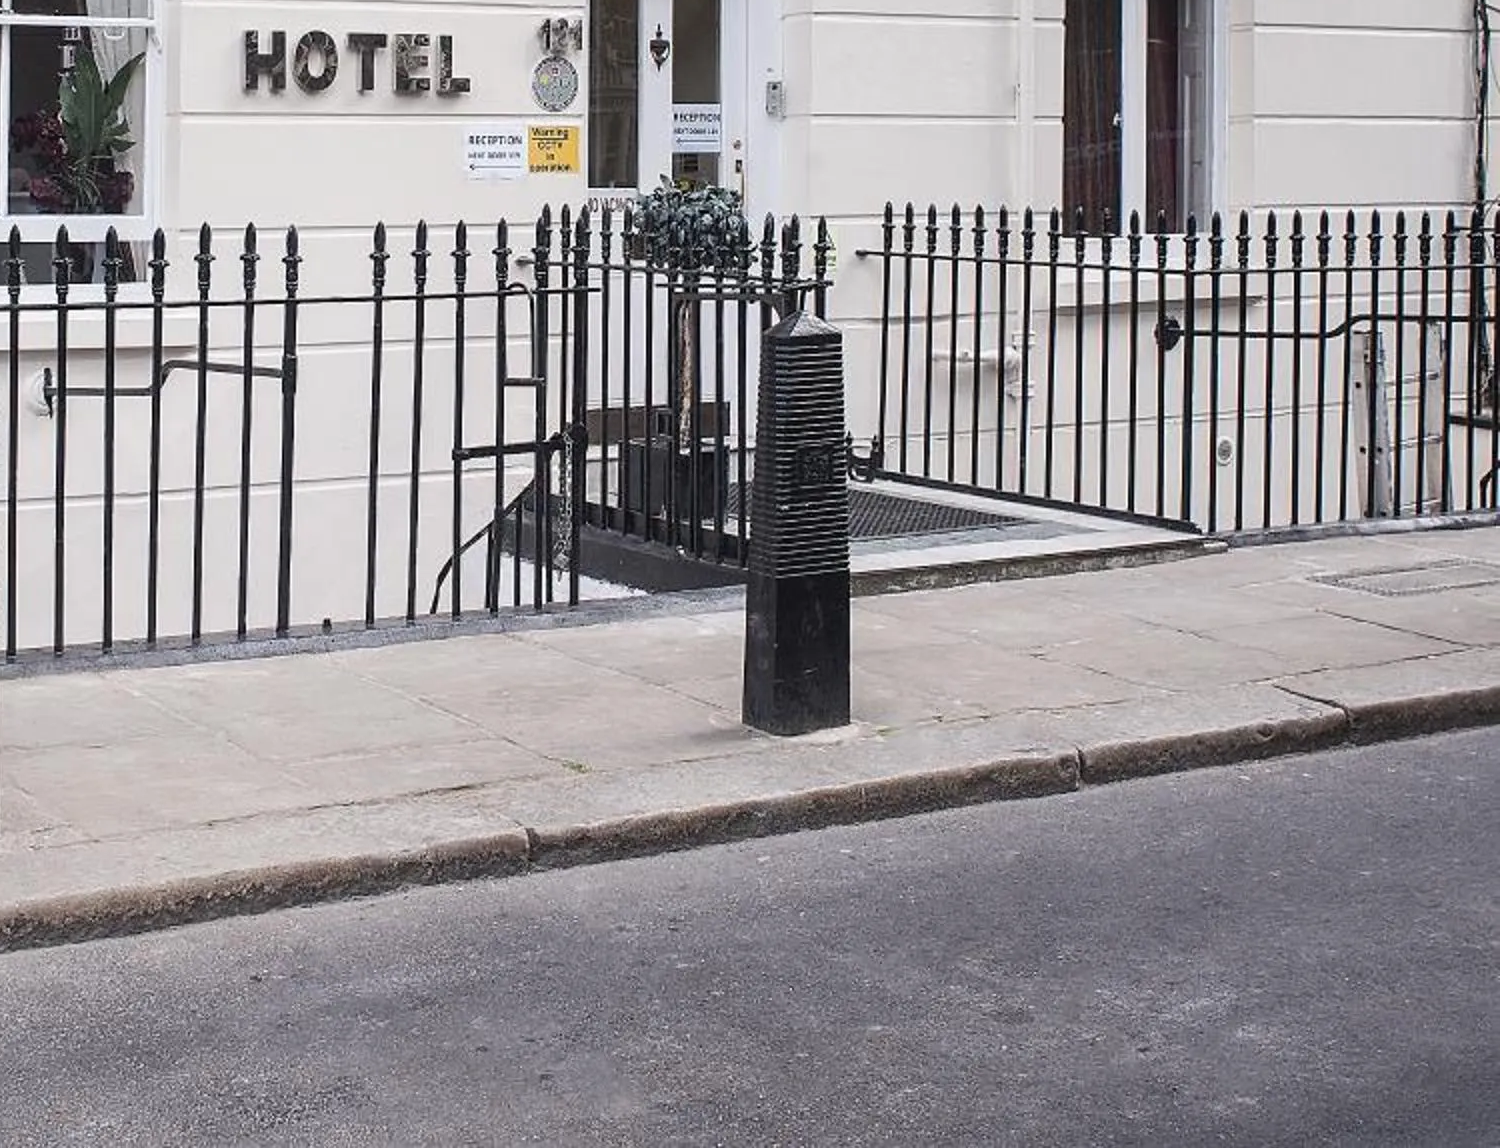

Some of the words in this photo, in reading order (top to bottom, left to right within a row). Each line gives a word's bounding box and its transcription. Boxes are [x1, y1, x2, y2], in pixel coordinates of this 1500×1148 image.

[243, 29, 471, 95] HOTEL
[673, 112, 721, 123] RECEPTION
[468, 134, 523, 146] RECEPTION
[531, 127, 569, 141] Warning
